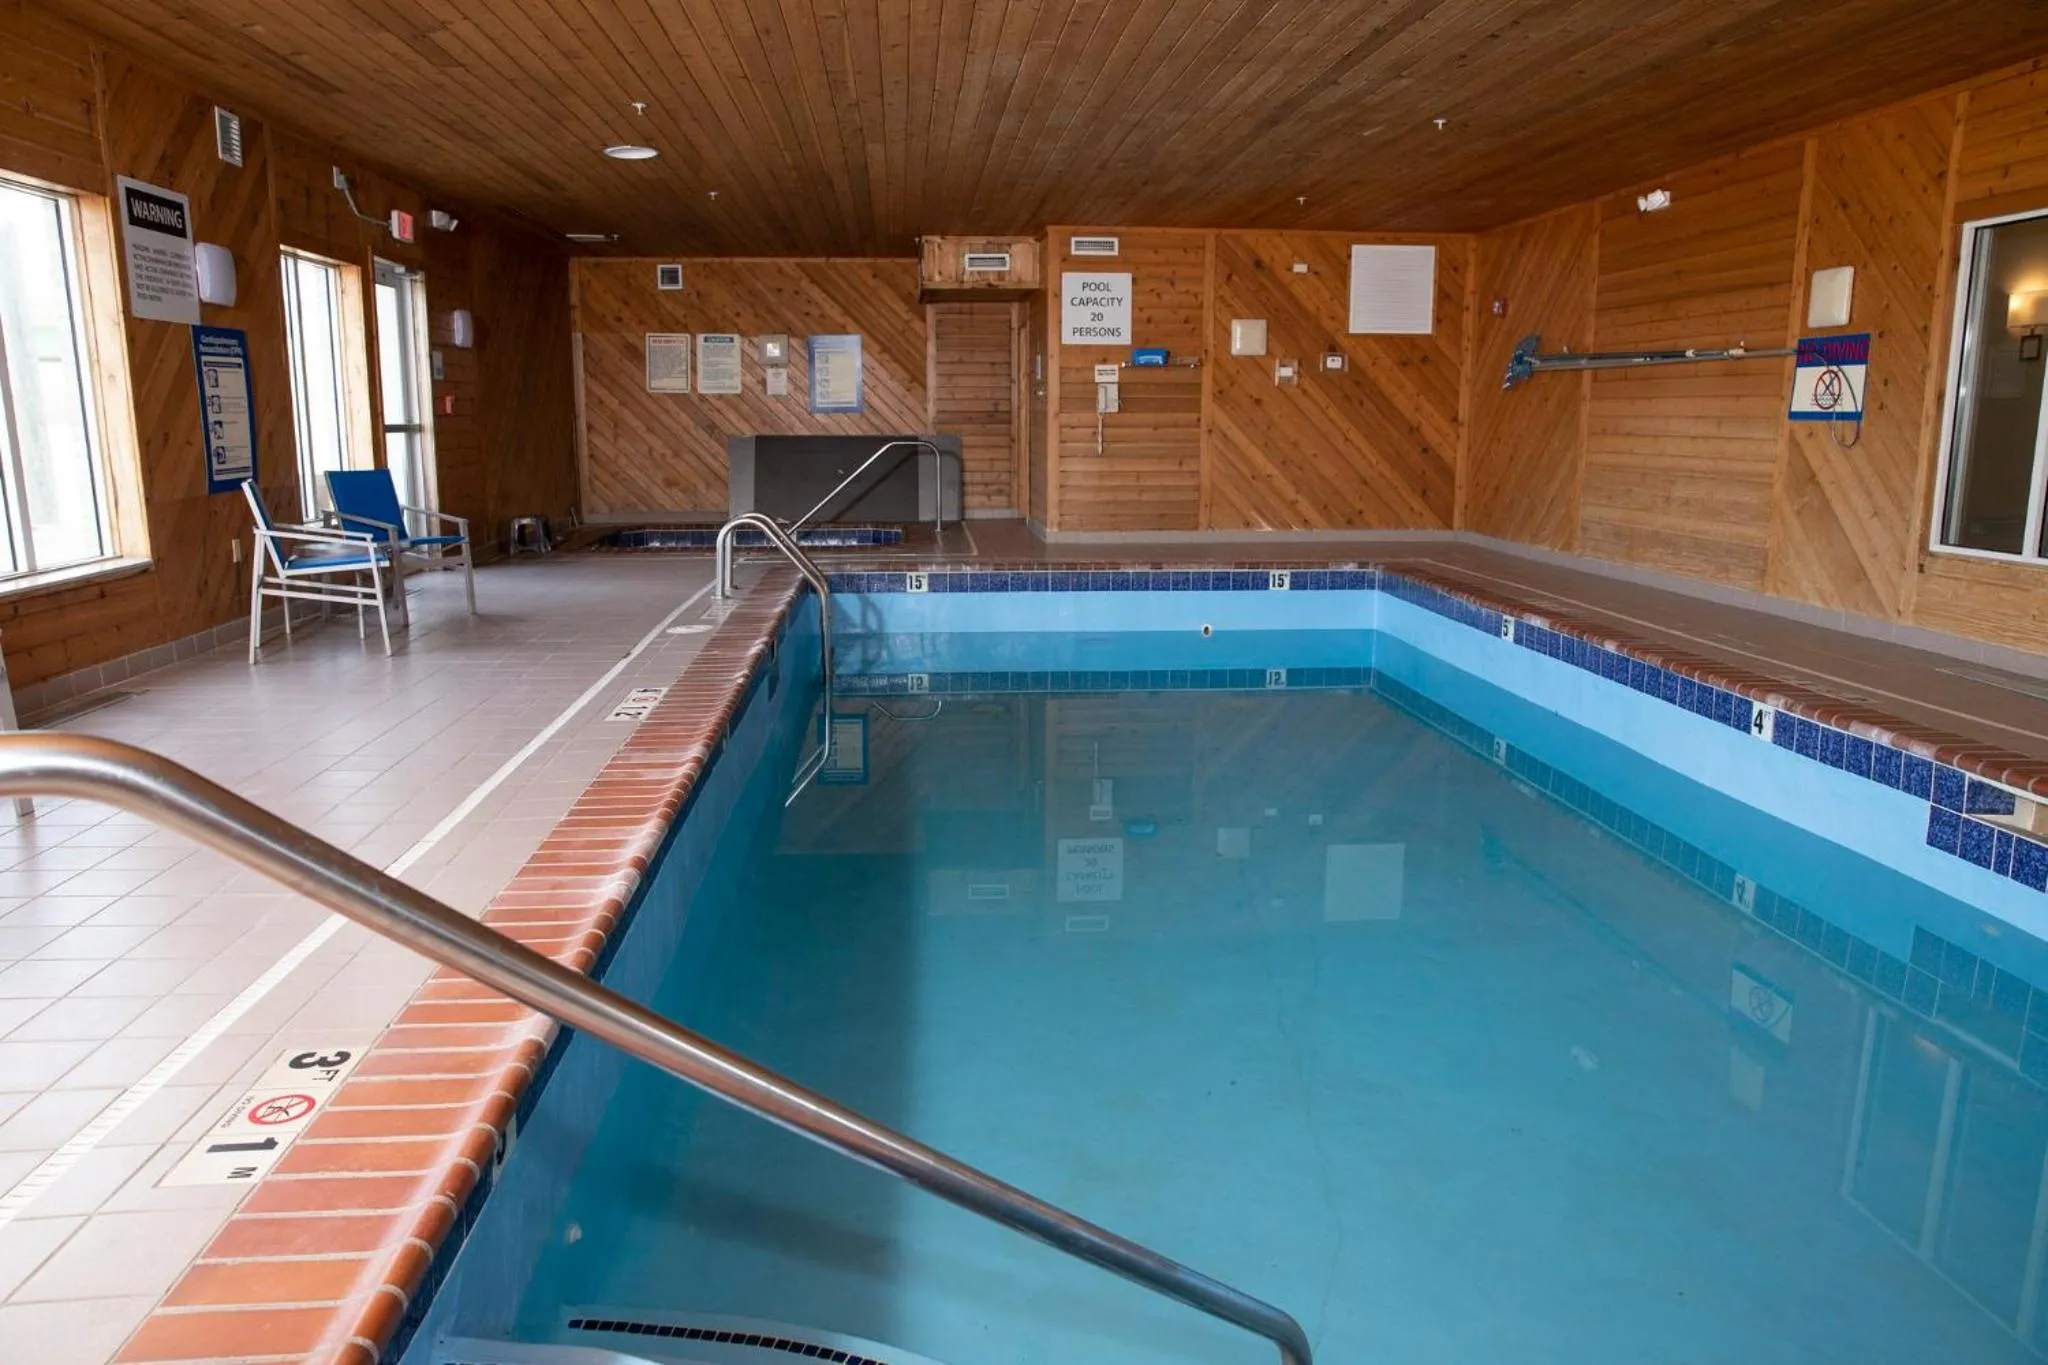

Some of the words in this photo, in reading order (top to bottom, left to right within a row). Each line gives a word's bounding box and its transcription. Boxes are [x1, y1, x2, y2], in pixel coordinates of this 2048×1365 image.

[131, 198, 183, 228] WARNING
[1082, 282, 1112, 292] POOL
[1070, 297, 1123, 307] CAPACITY
[1090, 312, 1104, 322] 20
[1072, 327, 1122, 337] PERSONS
[1753, 709, 1763, 735] 4
[289, 1051, 351, 1069] 3
[312, 1069, 340, 1082] FT
[206, 1137, 279, 1153] 1
[226, 1167, 258, 1179] M
